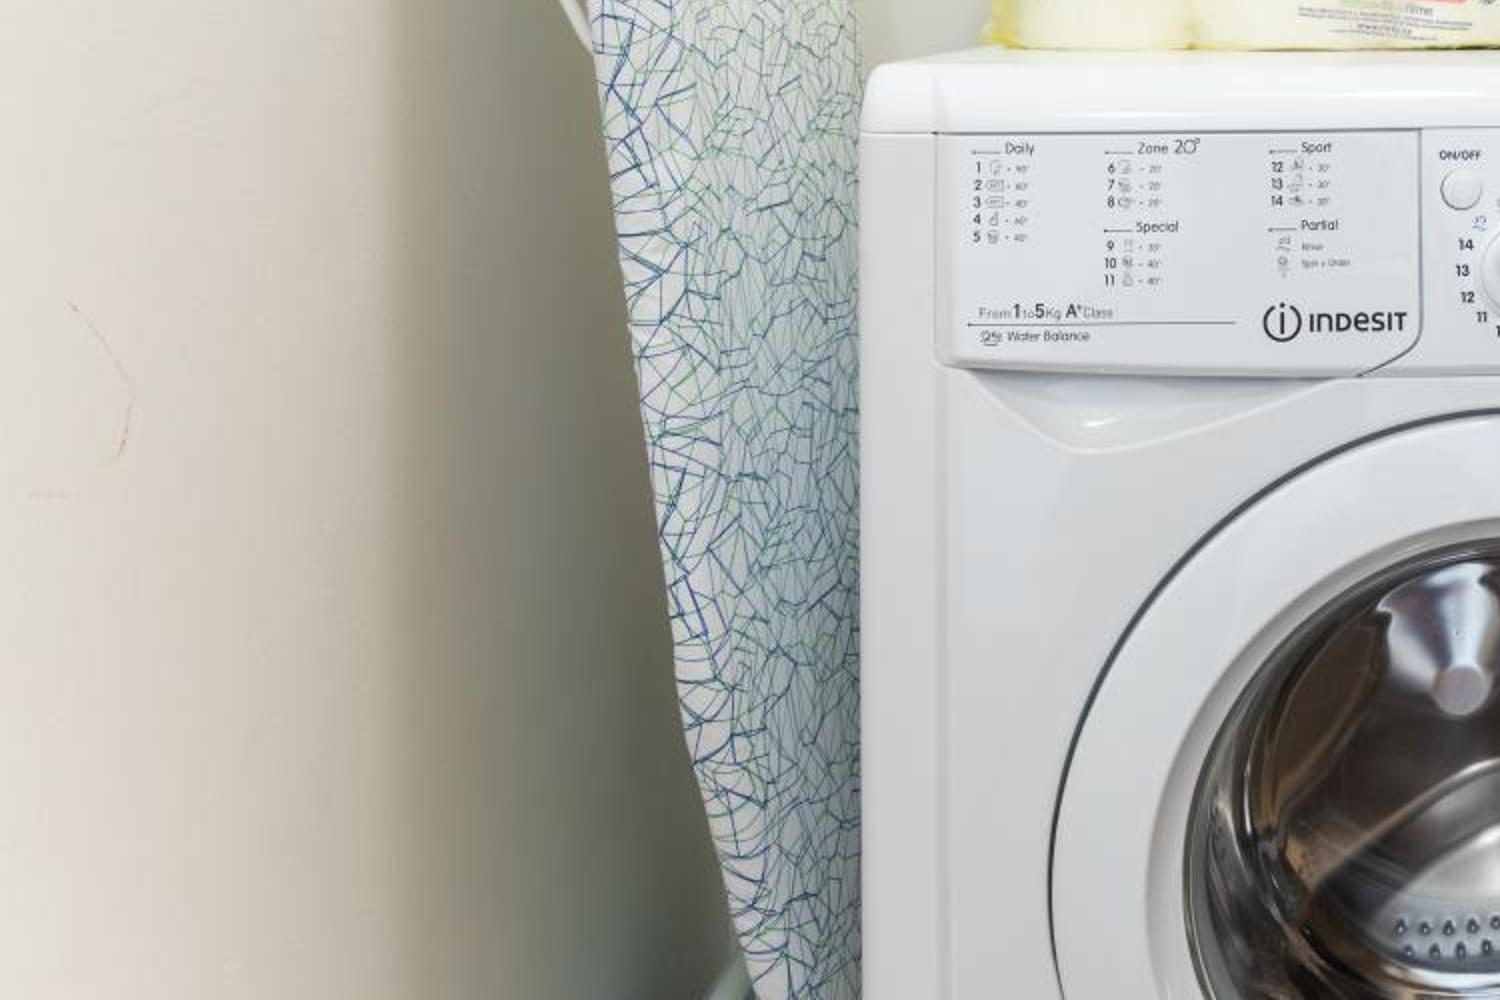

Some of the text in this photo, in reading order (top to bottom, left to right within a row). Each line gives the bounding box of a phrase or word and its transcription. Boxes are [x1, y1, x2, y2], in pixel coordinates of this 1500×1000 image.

[1005, 142, 1035, 156] Daily
[1137, 142, 1169, 155] Zone
[1301, 142, 1331, 154] Sport
[1439, 149, 1481, 160] ON/OFF
[976, 161, 981, 173] 1
[1107, 163, 1115, 174] 6
[1271, 161, 1283, 173] 12
[973, 180, 982, 191] 2
[1107, 179, 1115, 191] 7
[1271, 177, 1283, 190] 13
[972, 196, 981, 208] 3
[1107, 195, 1115, 208] 8
[1271, 195, 1283, 206] 14
[973, 213, 981, 224] 4
[1136, 221, 1179, 235] Special
[1301, 219, 1338, 231] Partial
[973, 231, 981, 243] 5
[1107, 240, 1115, 251] 9
[1458, 238, 1474, 250] 14
[1104, 257, 1117, 269] 10
[1455, 264, 1470, 276] 13
[1104, 274, 1115, 287] 11
[1460, 291, 1475, 303] 12
[1013, 303, 1020, 318] 1
[1035, 303, 1045, 318] 5
[1477, 311, 1487, 322] 11
[1308, 311, 1408, 332] INDESIT
[1007, 330, 1091, 342] Water Balance
